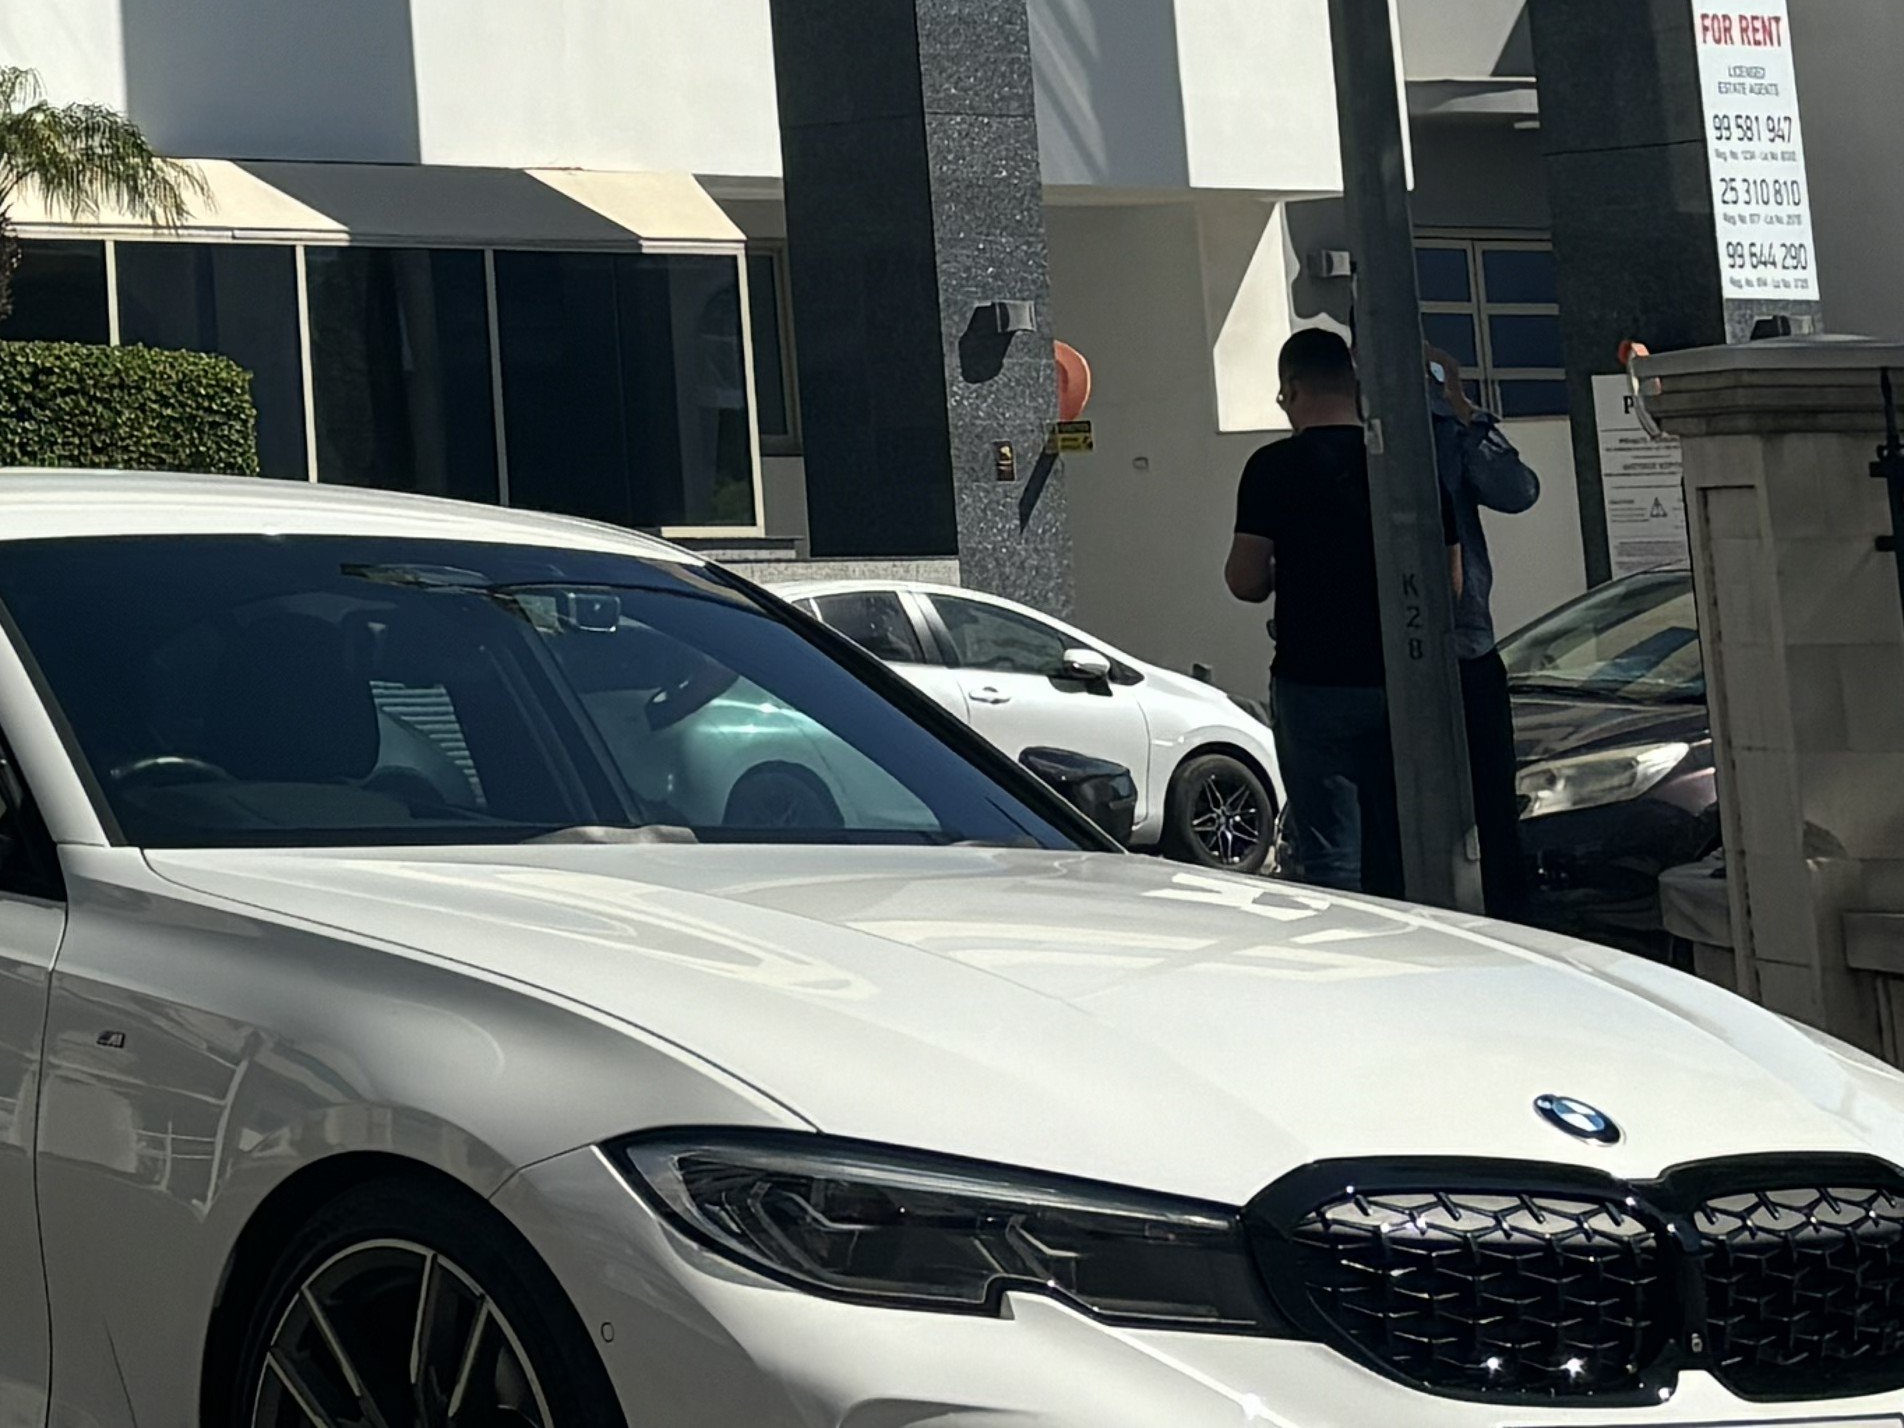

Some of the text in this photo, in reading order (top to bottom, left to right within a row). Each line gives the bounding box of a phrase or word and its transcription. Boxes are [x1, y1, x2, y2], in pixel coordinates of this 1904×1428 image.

[1701, 13, 1782, 47] FOR RENT
[1713, 114, 1792, 143] 99 581 947
[1720, 177, 1802, 206] 25 310 810
[1726, 241, 1808, 270] 99 644 290
